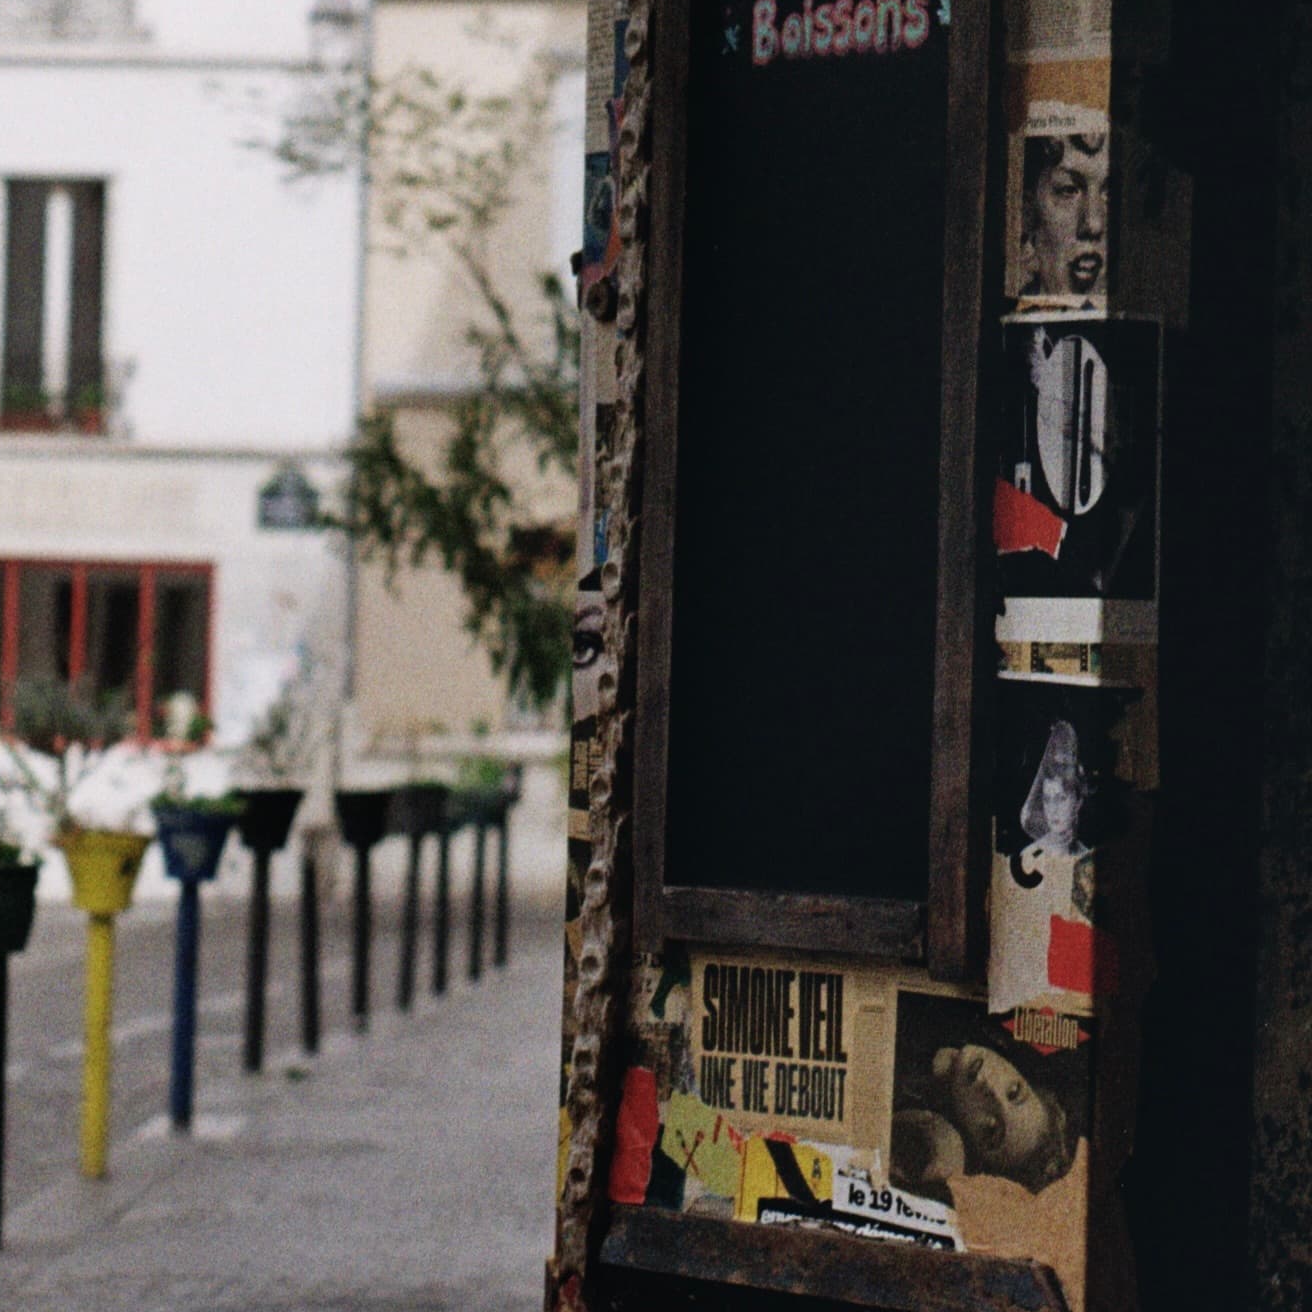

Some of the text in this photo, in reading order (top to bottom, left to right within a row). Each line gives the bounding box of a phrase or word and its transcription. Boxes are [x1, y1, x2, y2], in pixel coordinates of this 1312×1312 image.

[701, 962, 796, 1058] SIMONE
[798, 970, 848, 1063] VEIL
[700, 1055, 737, 1110] UNE
[742, 1058, 770, 1114] VIE
[773, 1062, 848, 1122] DEBOUT
[848, 1184, 865, 1206] le
[869, 1189, 893, 1213] 19
